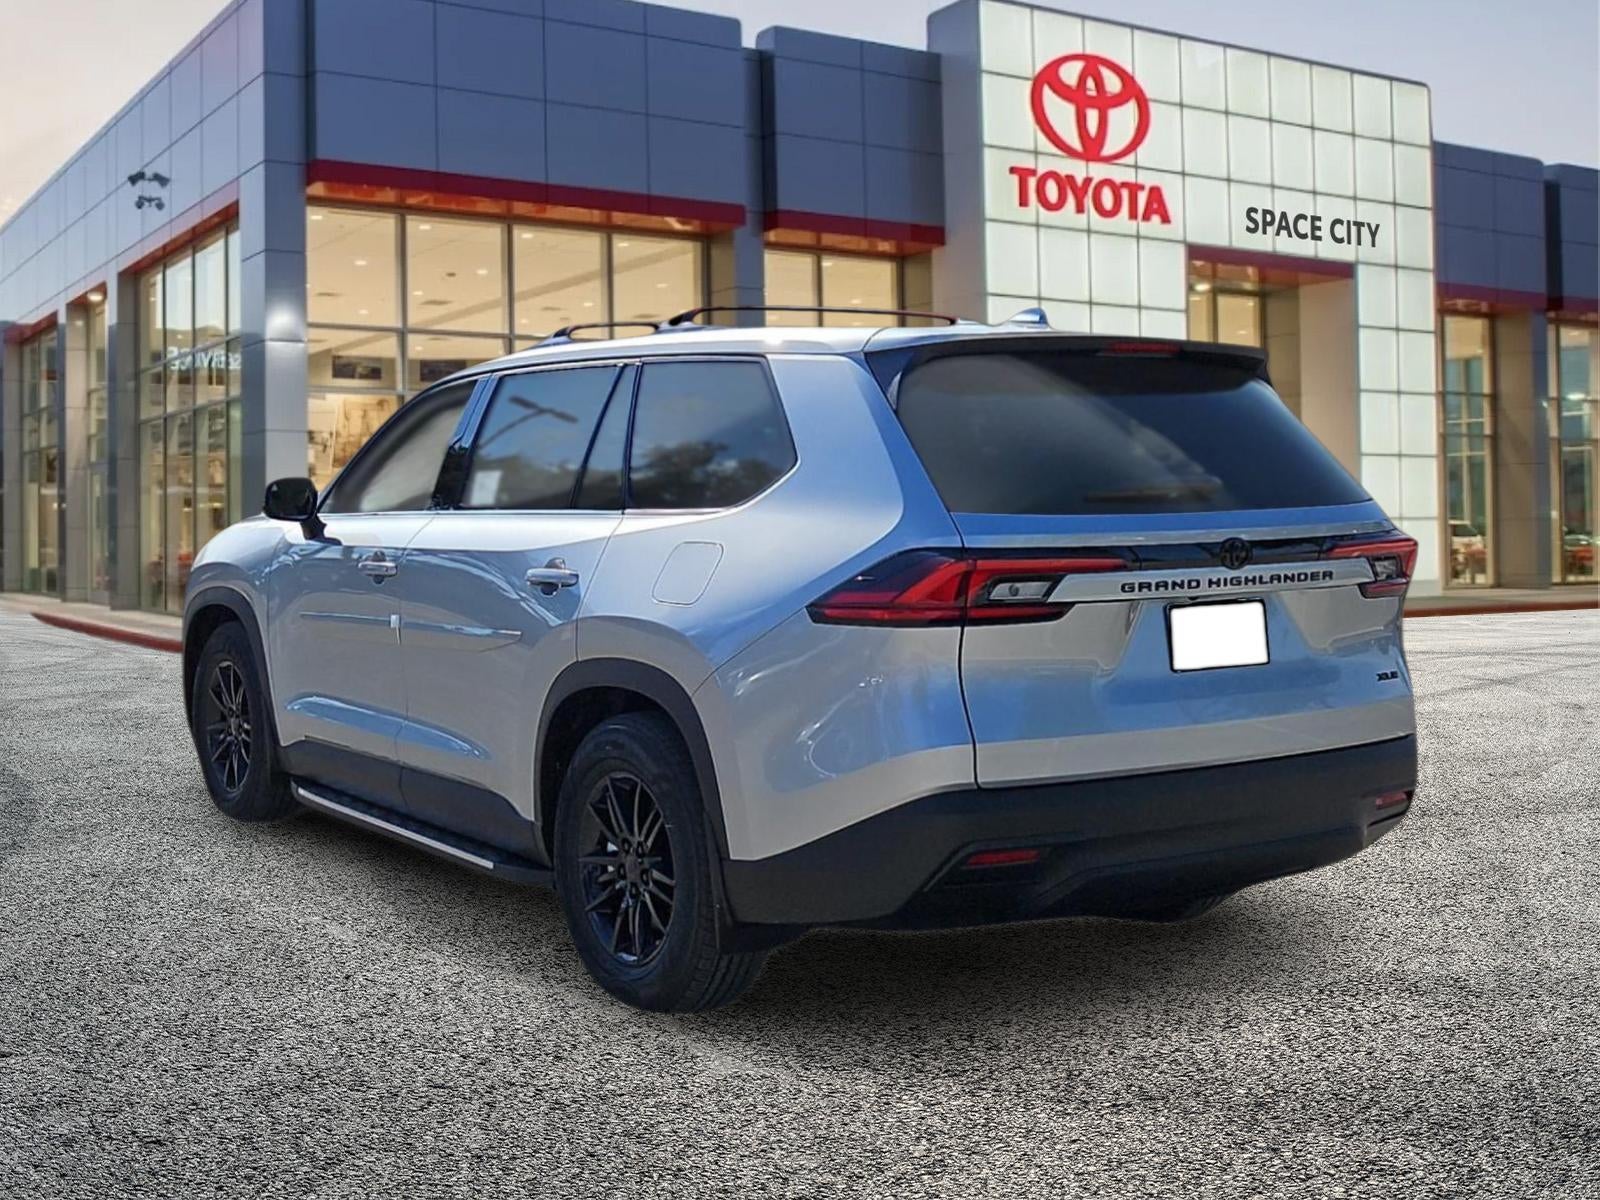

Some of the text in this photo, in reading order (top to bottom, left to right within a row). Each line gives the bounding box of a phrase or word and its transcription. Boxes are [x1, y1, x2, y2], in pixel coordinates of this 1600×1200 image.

[1009, 166, 1171, 224] TOYOTA
[1245, 207, 1381, 248] SPACE CITY
[1120, 570, 1334, 594] GRAND HIGHLANDER
